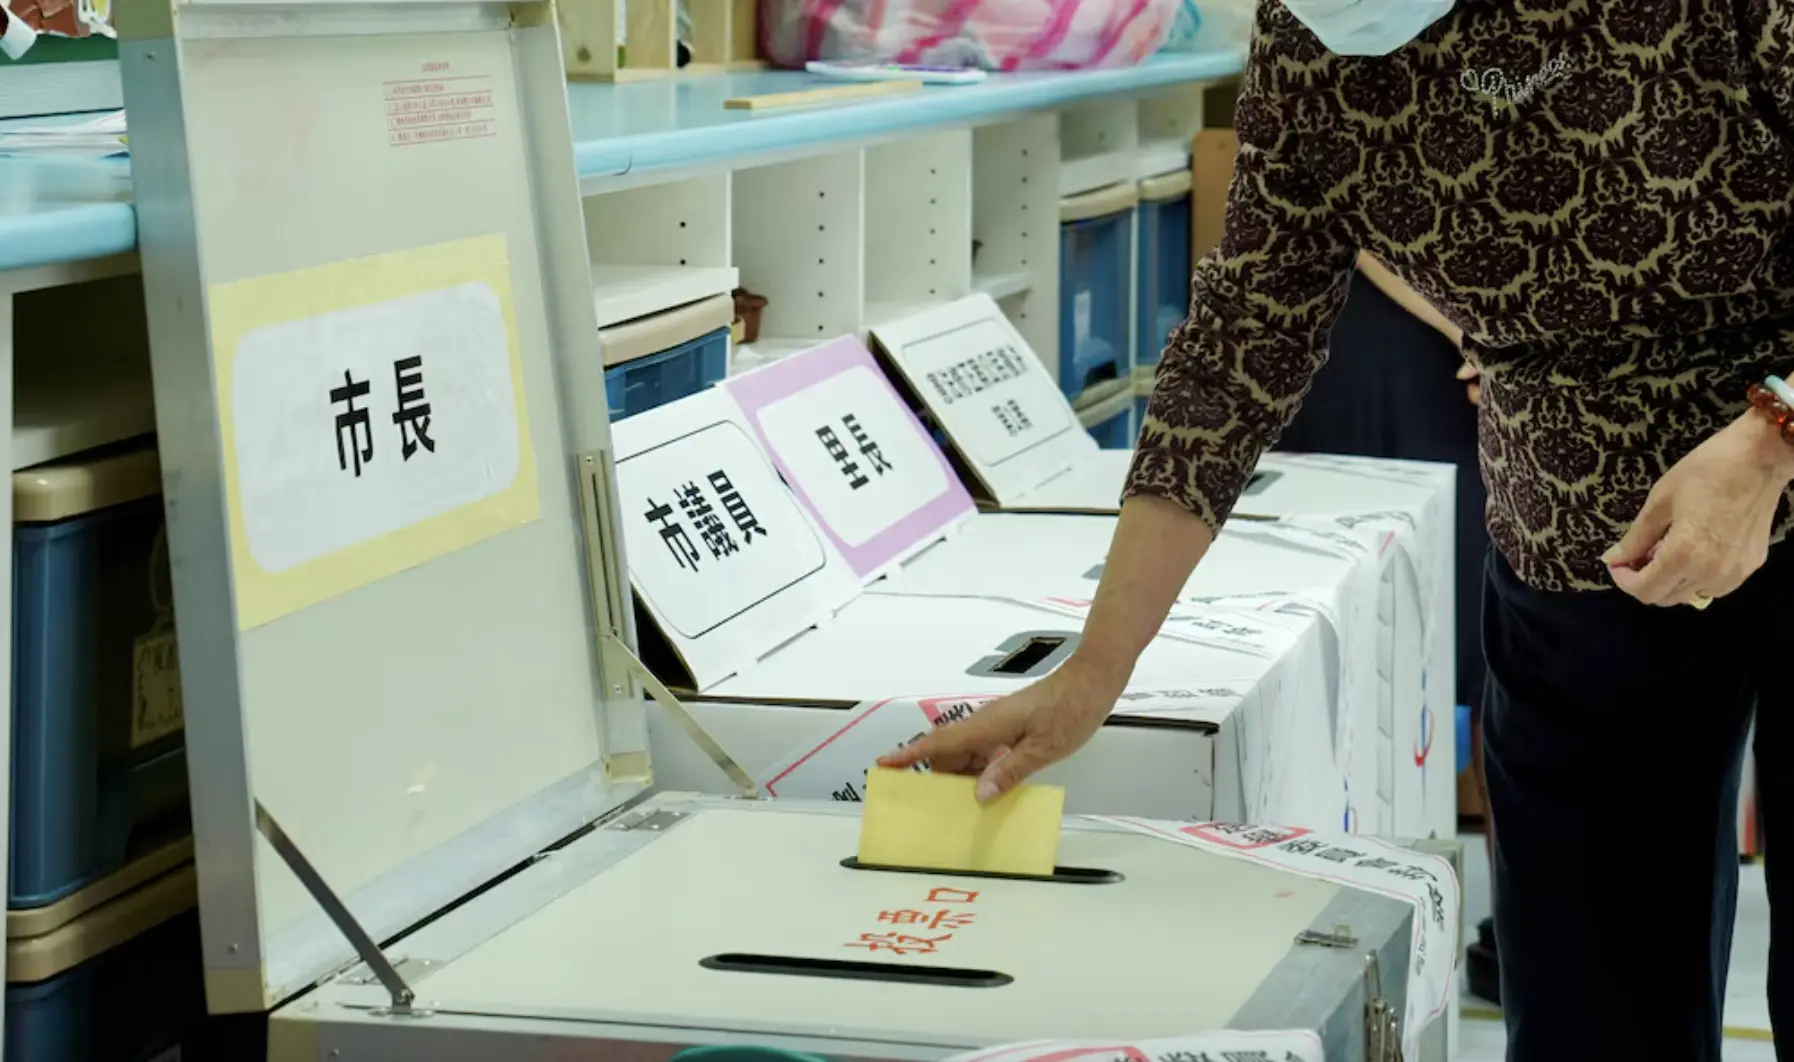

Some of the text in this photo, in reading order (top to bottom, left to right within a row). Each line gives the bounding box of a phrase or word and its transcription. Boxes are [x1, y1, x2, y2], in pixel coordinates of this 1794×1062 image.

[329, 354, 436, 478] 市長
[815, 414, 893, 490] 里長
[644, 469, 767, 573] 市議員
[844, 887, 980, 955] 投票口
